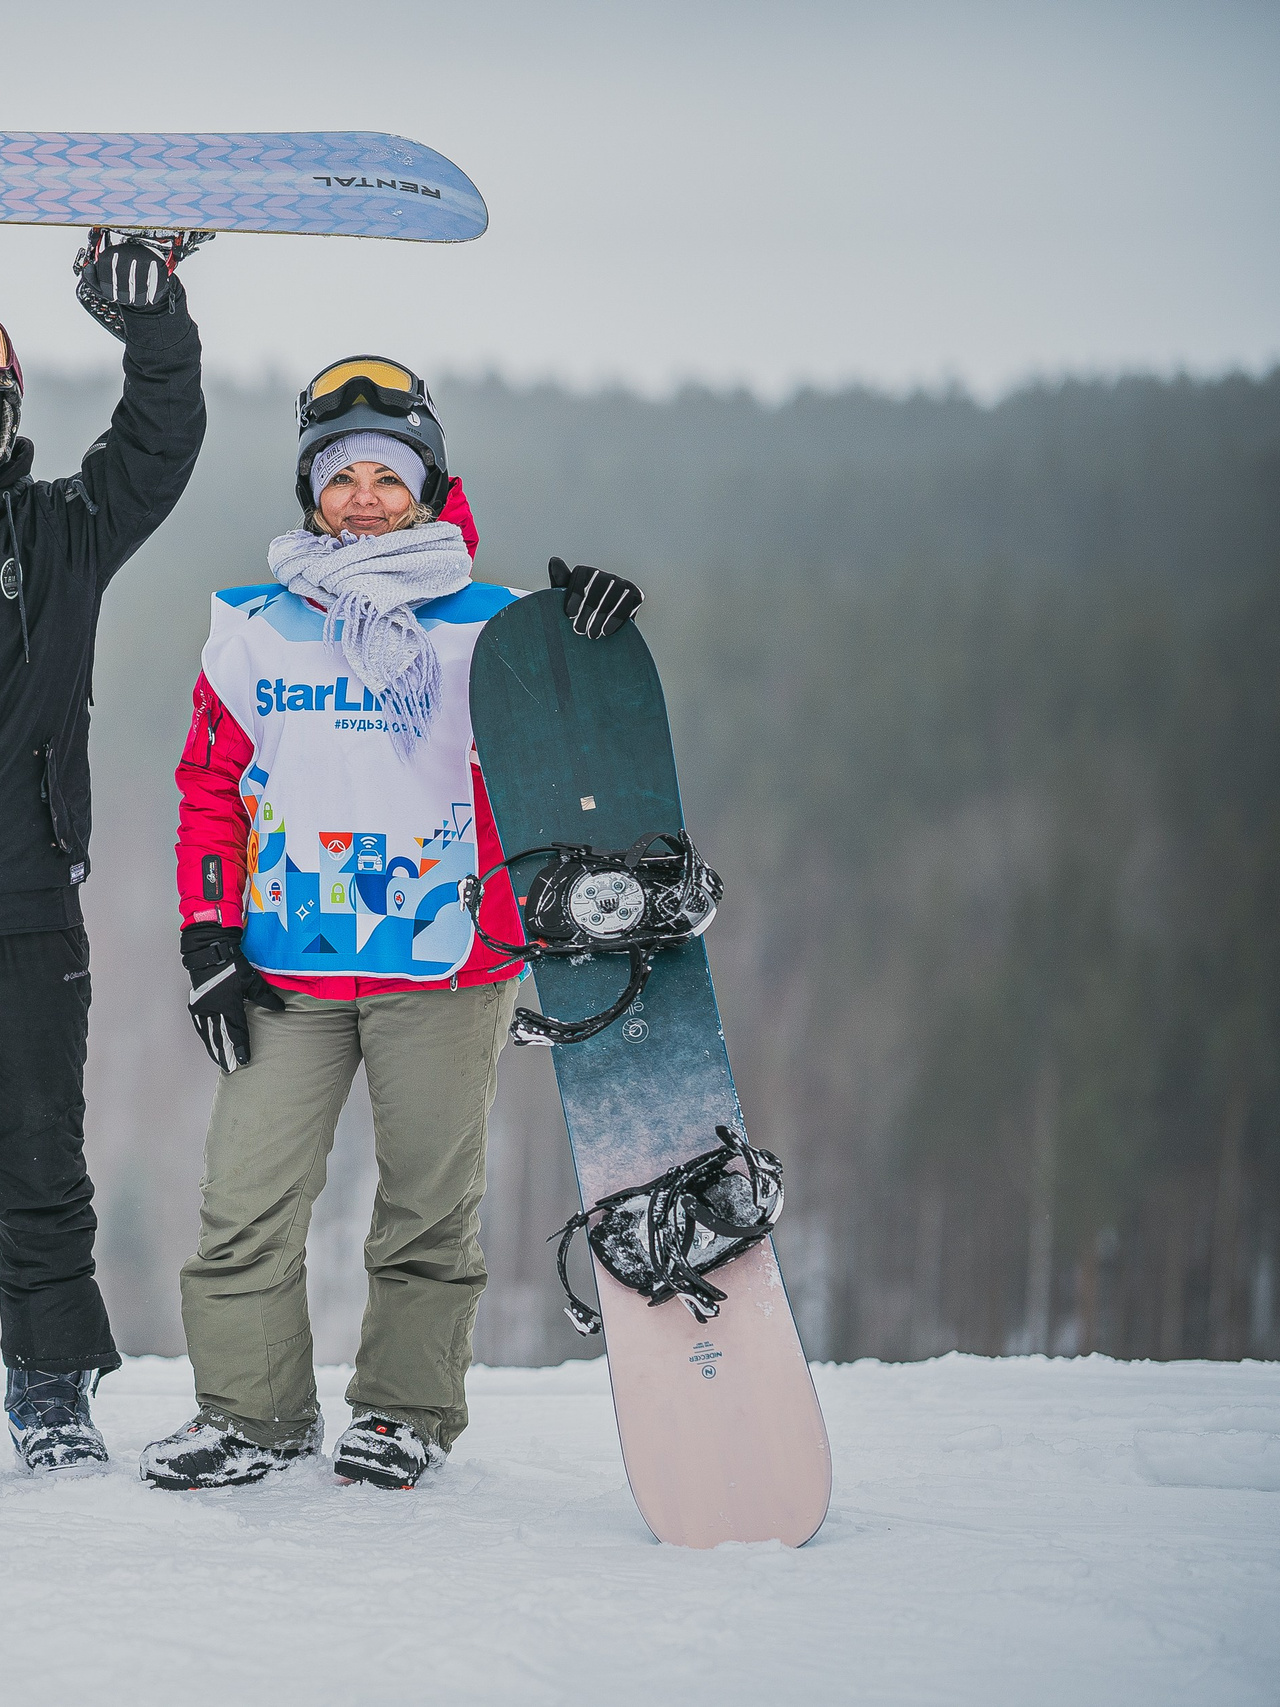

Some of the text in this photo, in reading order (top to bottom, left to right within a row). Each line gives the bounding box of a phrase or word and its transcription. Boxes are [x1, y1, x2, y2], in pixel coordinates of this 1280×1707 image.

[312, 176, 442, 200] RENTAL
[326, 444, 341, 460] GIRL
[622, 1001, 645, 1016] ell
[688, 1351, 723, 1363] NIDECKER
